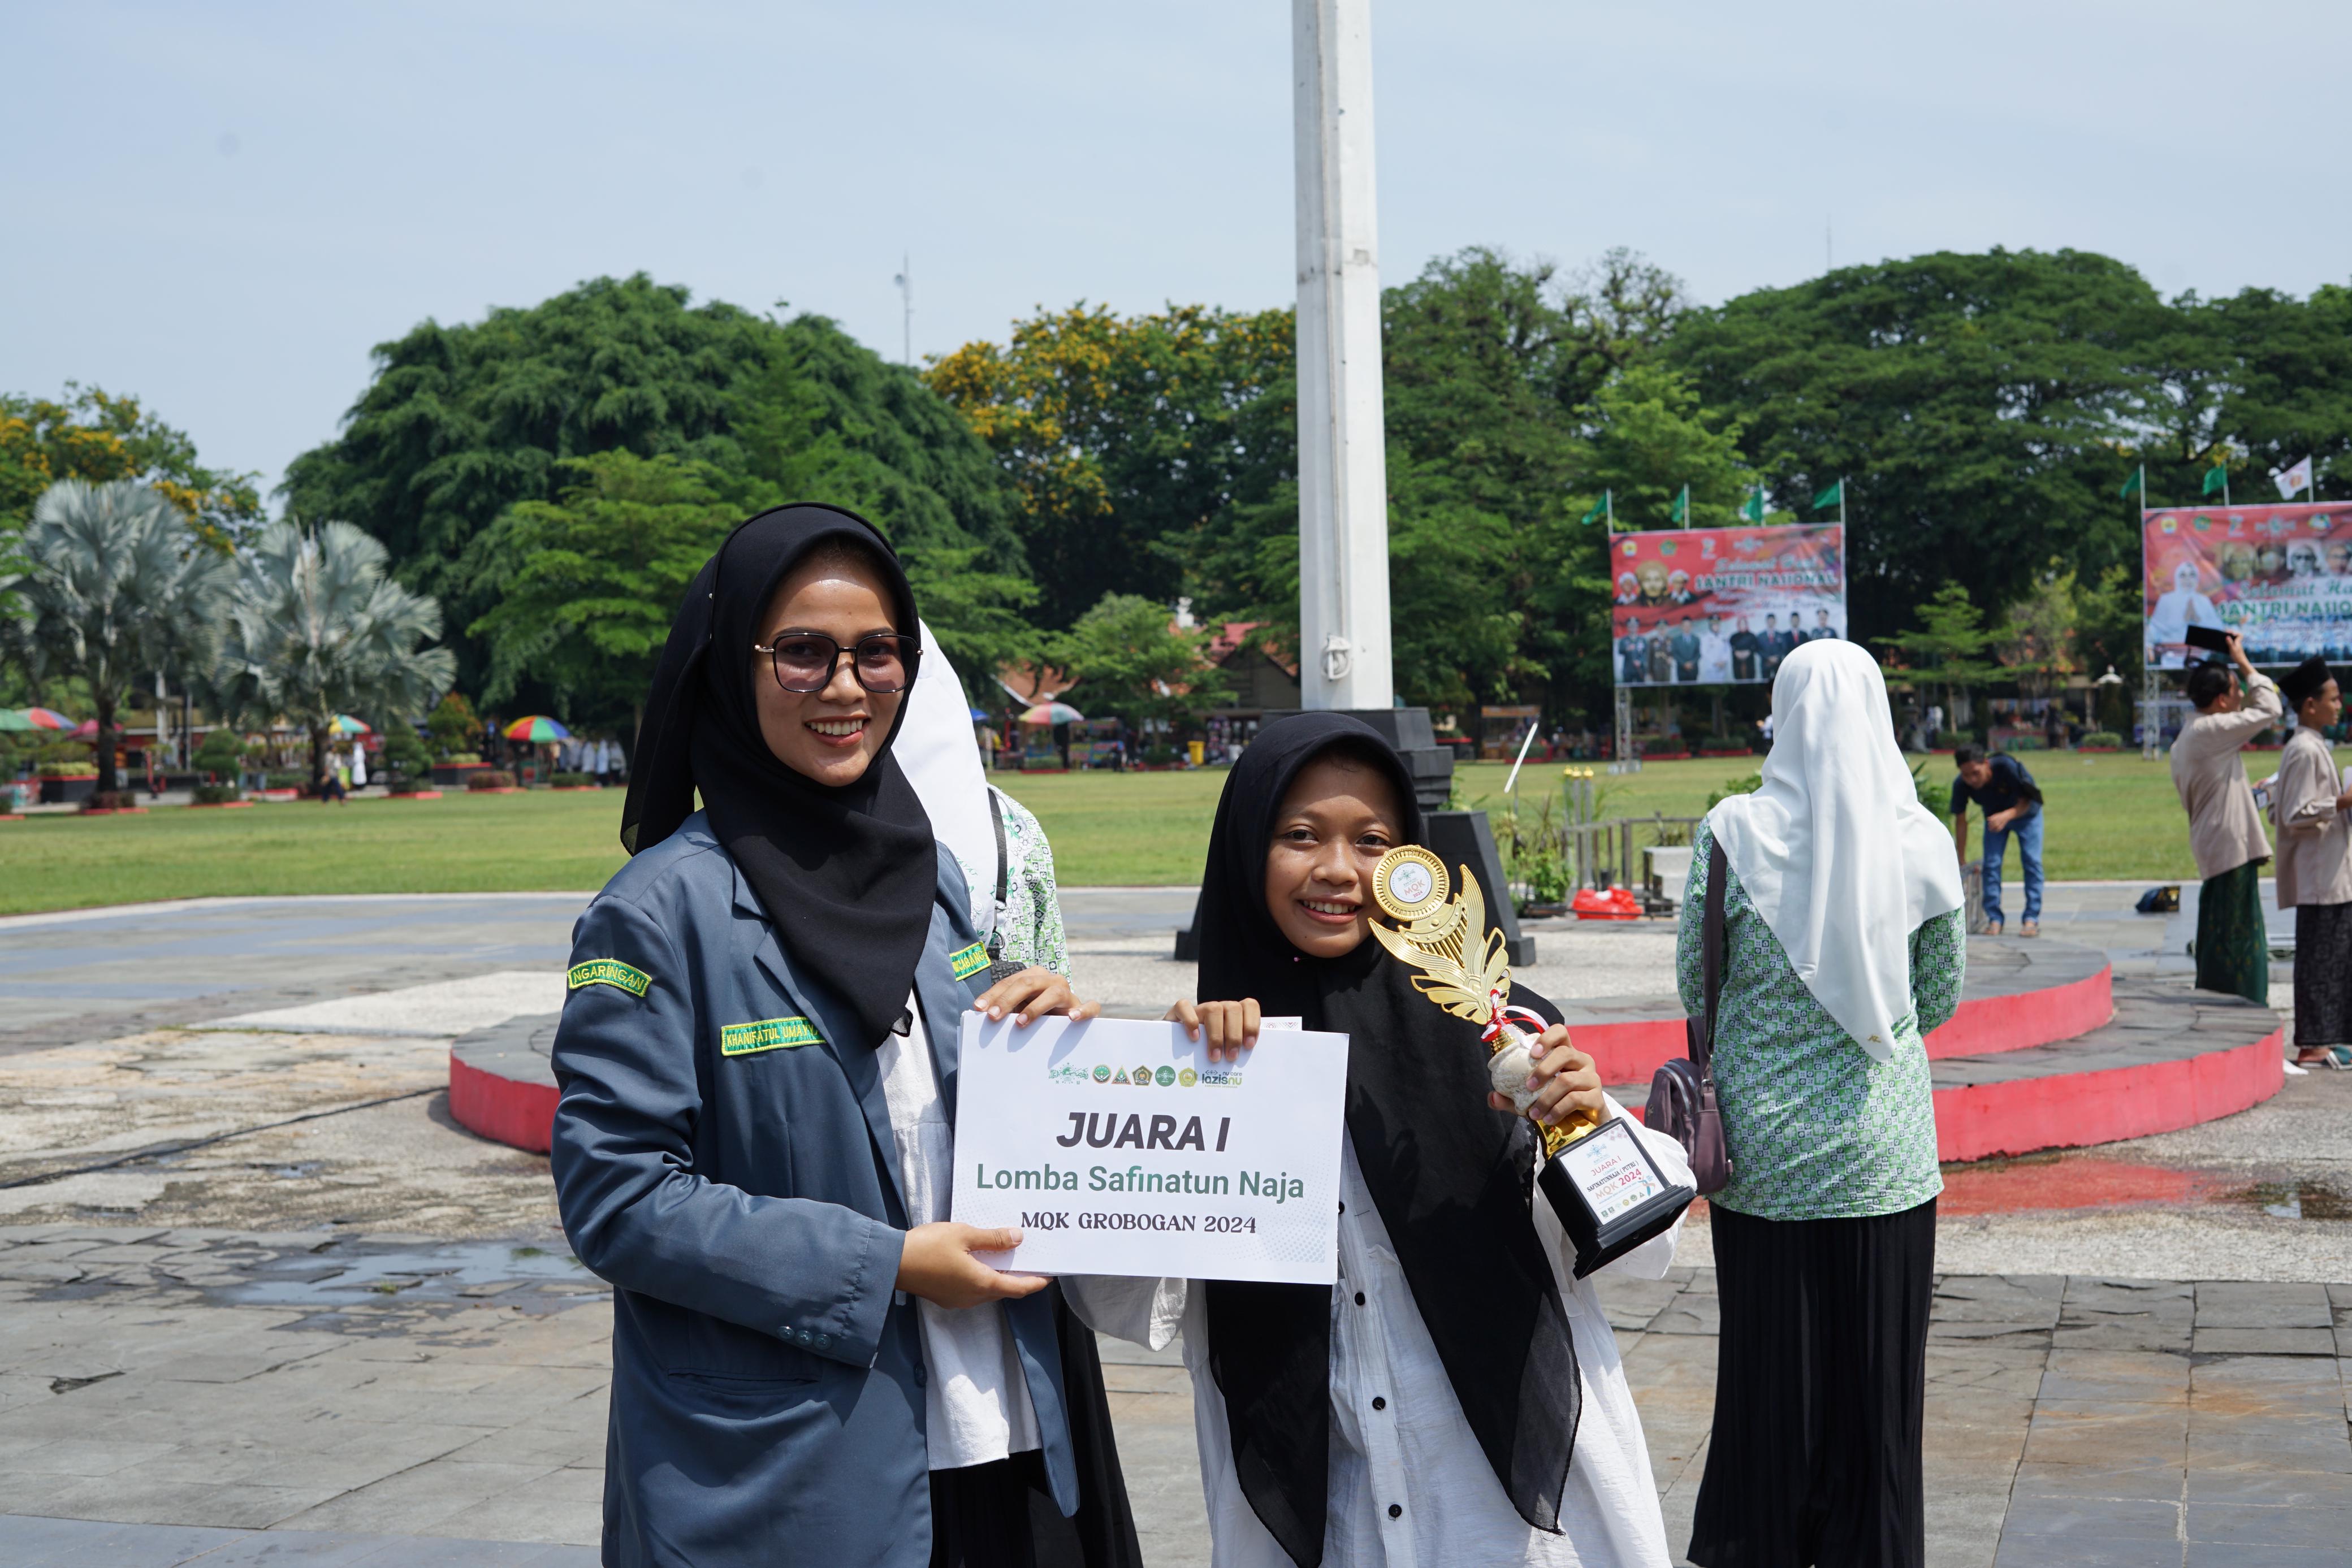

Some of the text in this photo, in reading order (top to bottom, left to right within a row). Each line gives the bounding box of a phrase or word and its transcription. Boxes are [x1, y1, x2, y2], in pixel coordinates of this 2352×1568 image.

[1695, 570, 1839, 590] SANTRI NASIONAL
[2239, 581, 2315, 597] Selamat
[2220, 603, 2289, 616] SANTRI
[1404, 879, 1425, 896] MQK
[958, 950, 984, 971] CABANG
[573, 965, 644, 990] NGARINGAN
[727, 1028, 780, 1046] KHANIFATUL
[1201, 1073, 1242, 1085] lazisnu
[1056, 1112, 1230, 1152] JUARA I
[1590, 1158, 1618, 1176] JUARA
[977, 1163, 1303, 1204] Lomba Safinatun Naja
[1596, 1182, 1619, 1199] MQK
[1619, 1168, 1642, 1186] 2024
[1021, 1212, 1256, 1233] MQK GROBOGAN 2024
